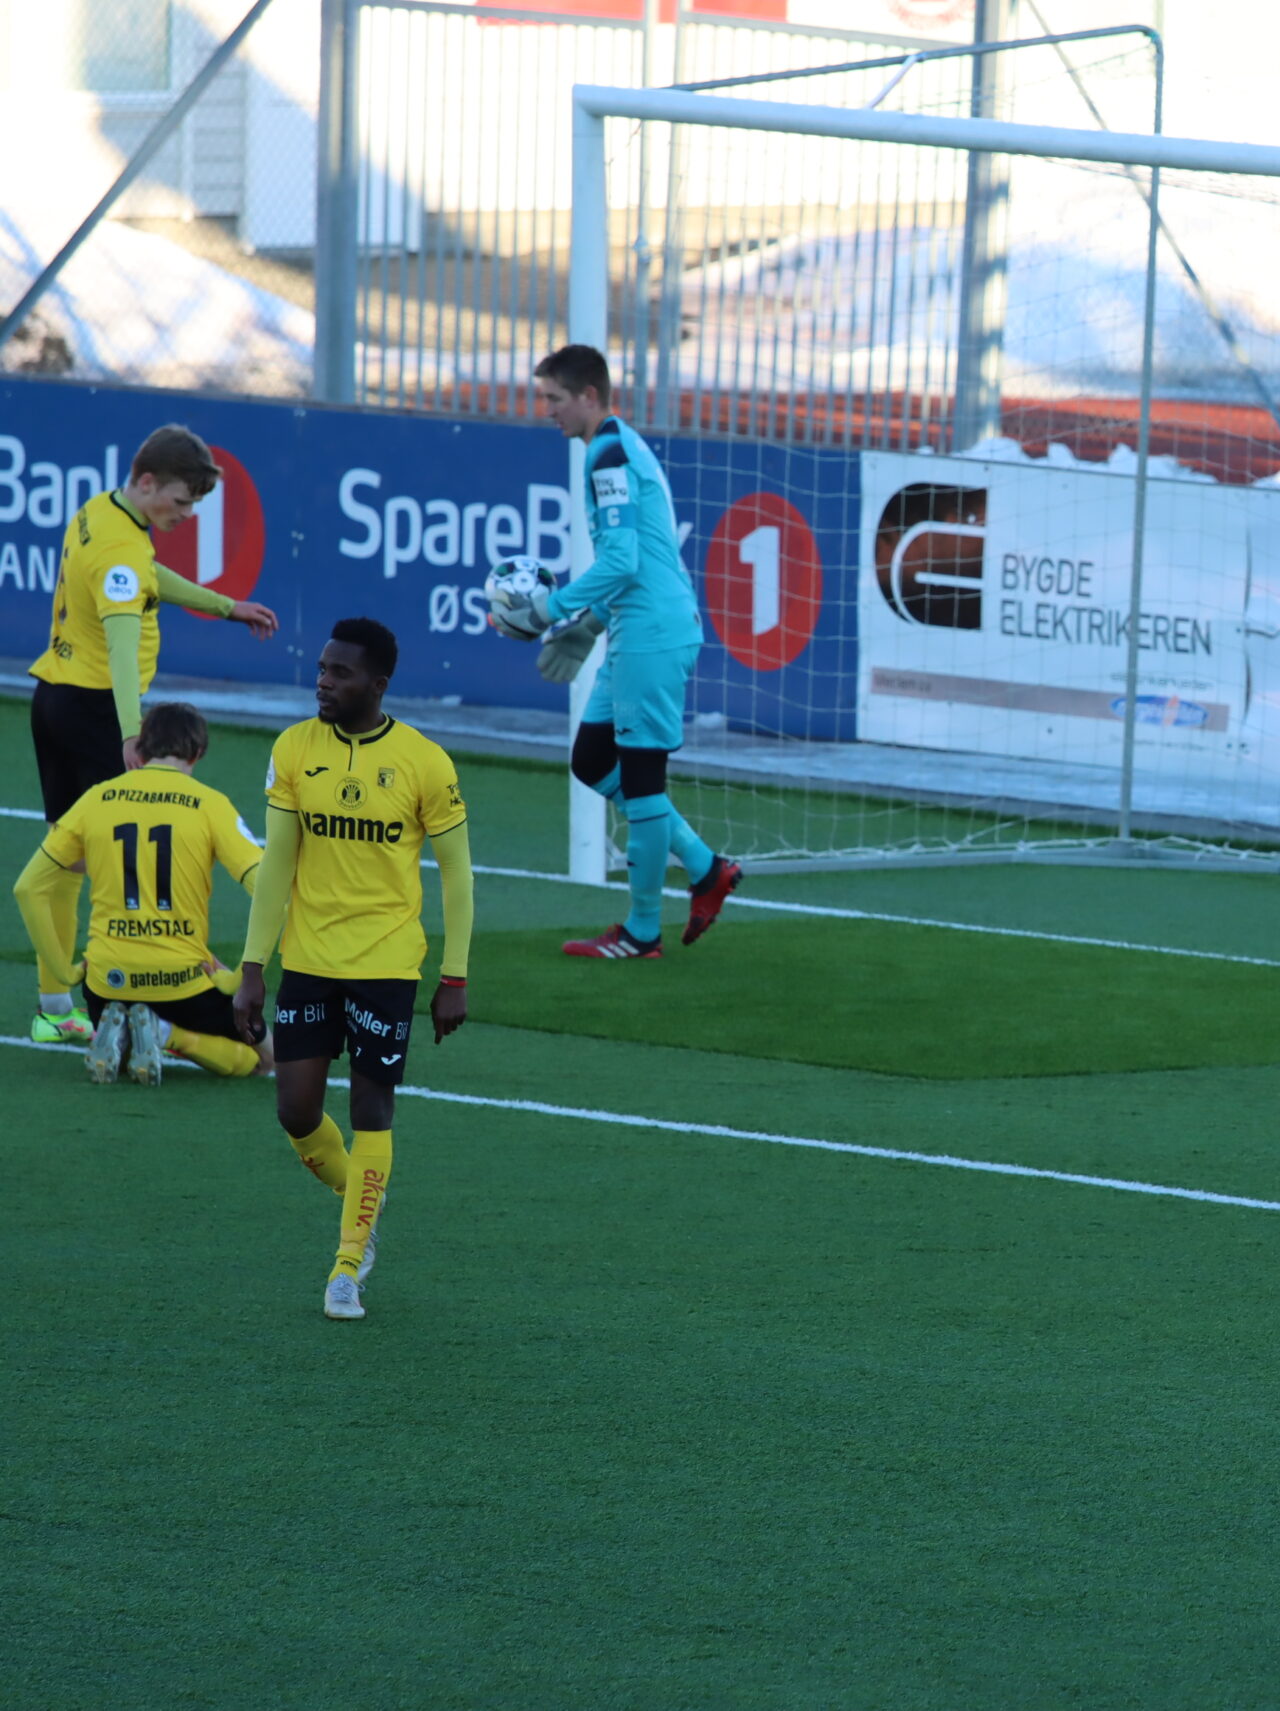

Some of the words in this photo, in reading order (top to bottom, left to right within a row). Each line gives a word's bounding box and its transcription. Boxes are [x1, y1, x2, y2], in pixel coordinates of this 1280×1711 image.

[739, 524, 780, 636] 1
[1002, 553, 1095, 598] BYGDE
[1001, 600, 1212, 656] ELEKTRIKEREN
[113, 822, 173, 911] 11
[130, 963, 204, 988] gatelaget.n
[304, 1003, 326, 1023] Bil
